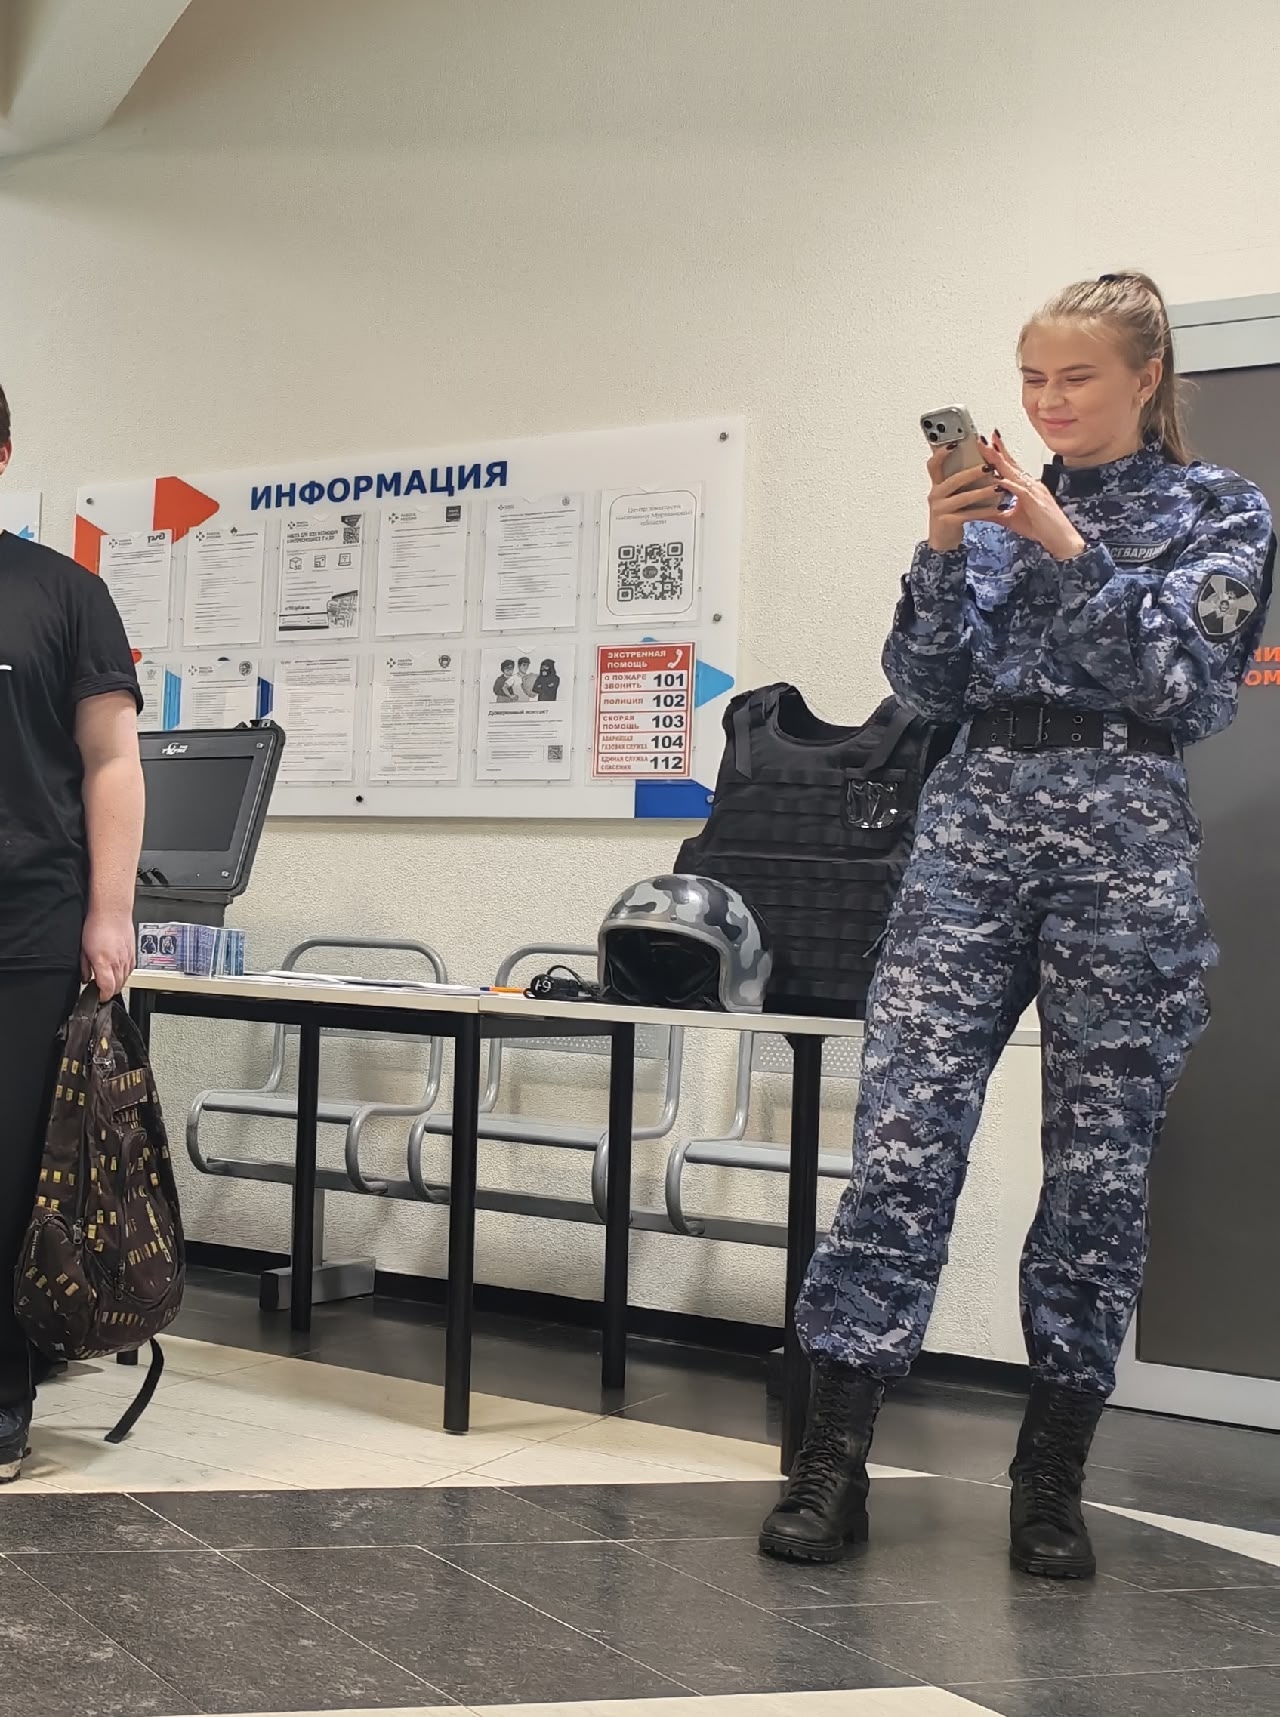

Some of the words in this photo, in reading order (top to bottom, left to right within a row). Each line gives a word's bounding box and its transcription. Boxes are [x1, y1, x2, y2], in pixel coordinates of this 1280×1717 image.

[250, 460, 508, 510] ИНФОРМАЦИЯ
[607, 650, 667, 659] ЭКСТРЕННАЯ
[607, 660, 648, 669] ПОМОЩЬ
[604, 681, 642, 690] ЗВОНИТЬ
[653, 673, 685, 687] 101
[652, 694, 686, 708] 102
[651, 715, 685, 729] 103
[651, 735, 684, 749] 104
[650, 756, 684, 770] 112
